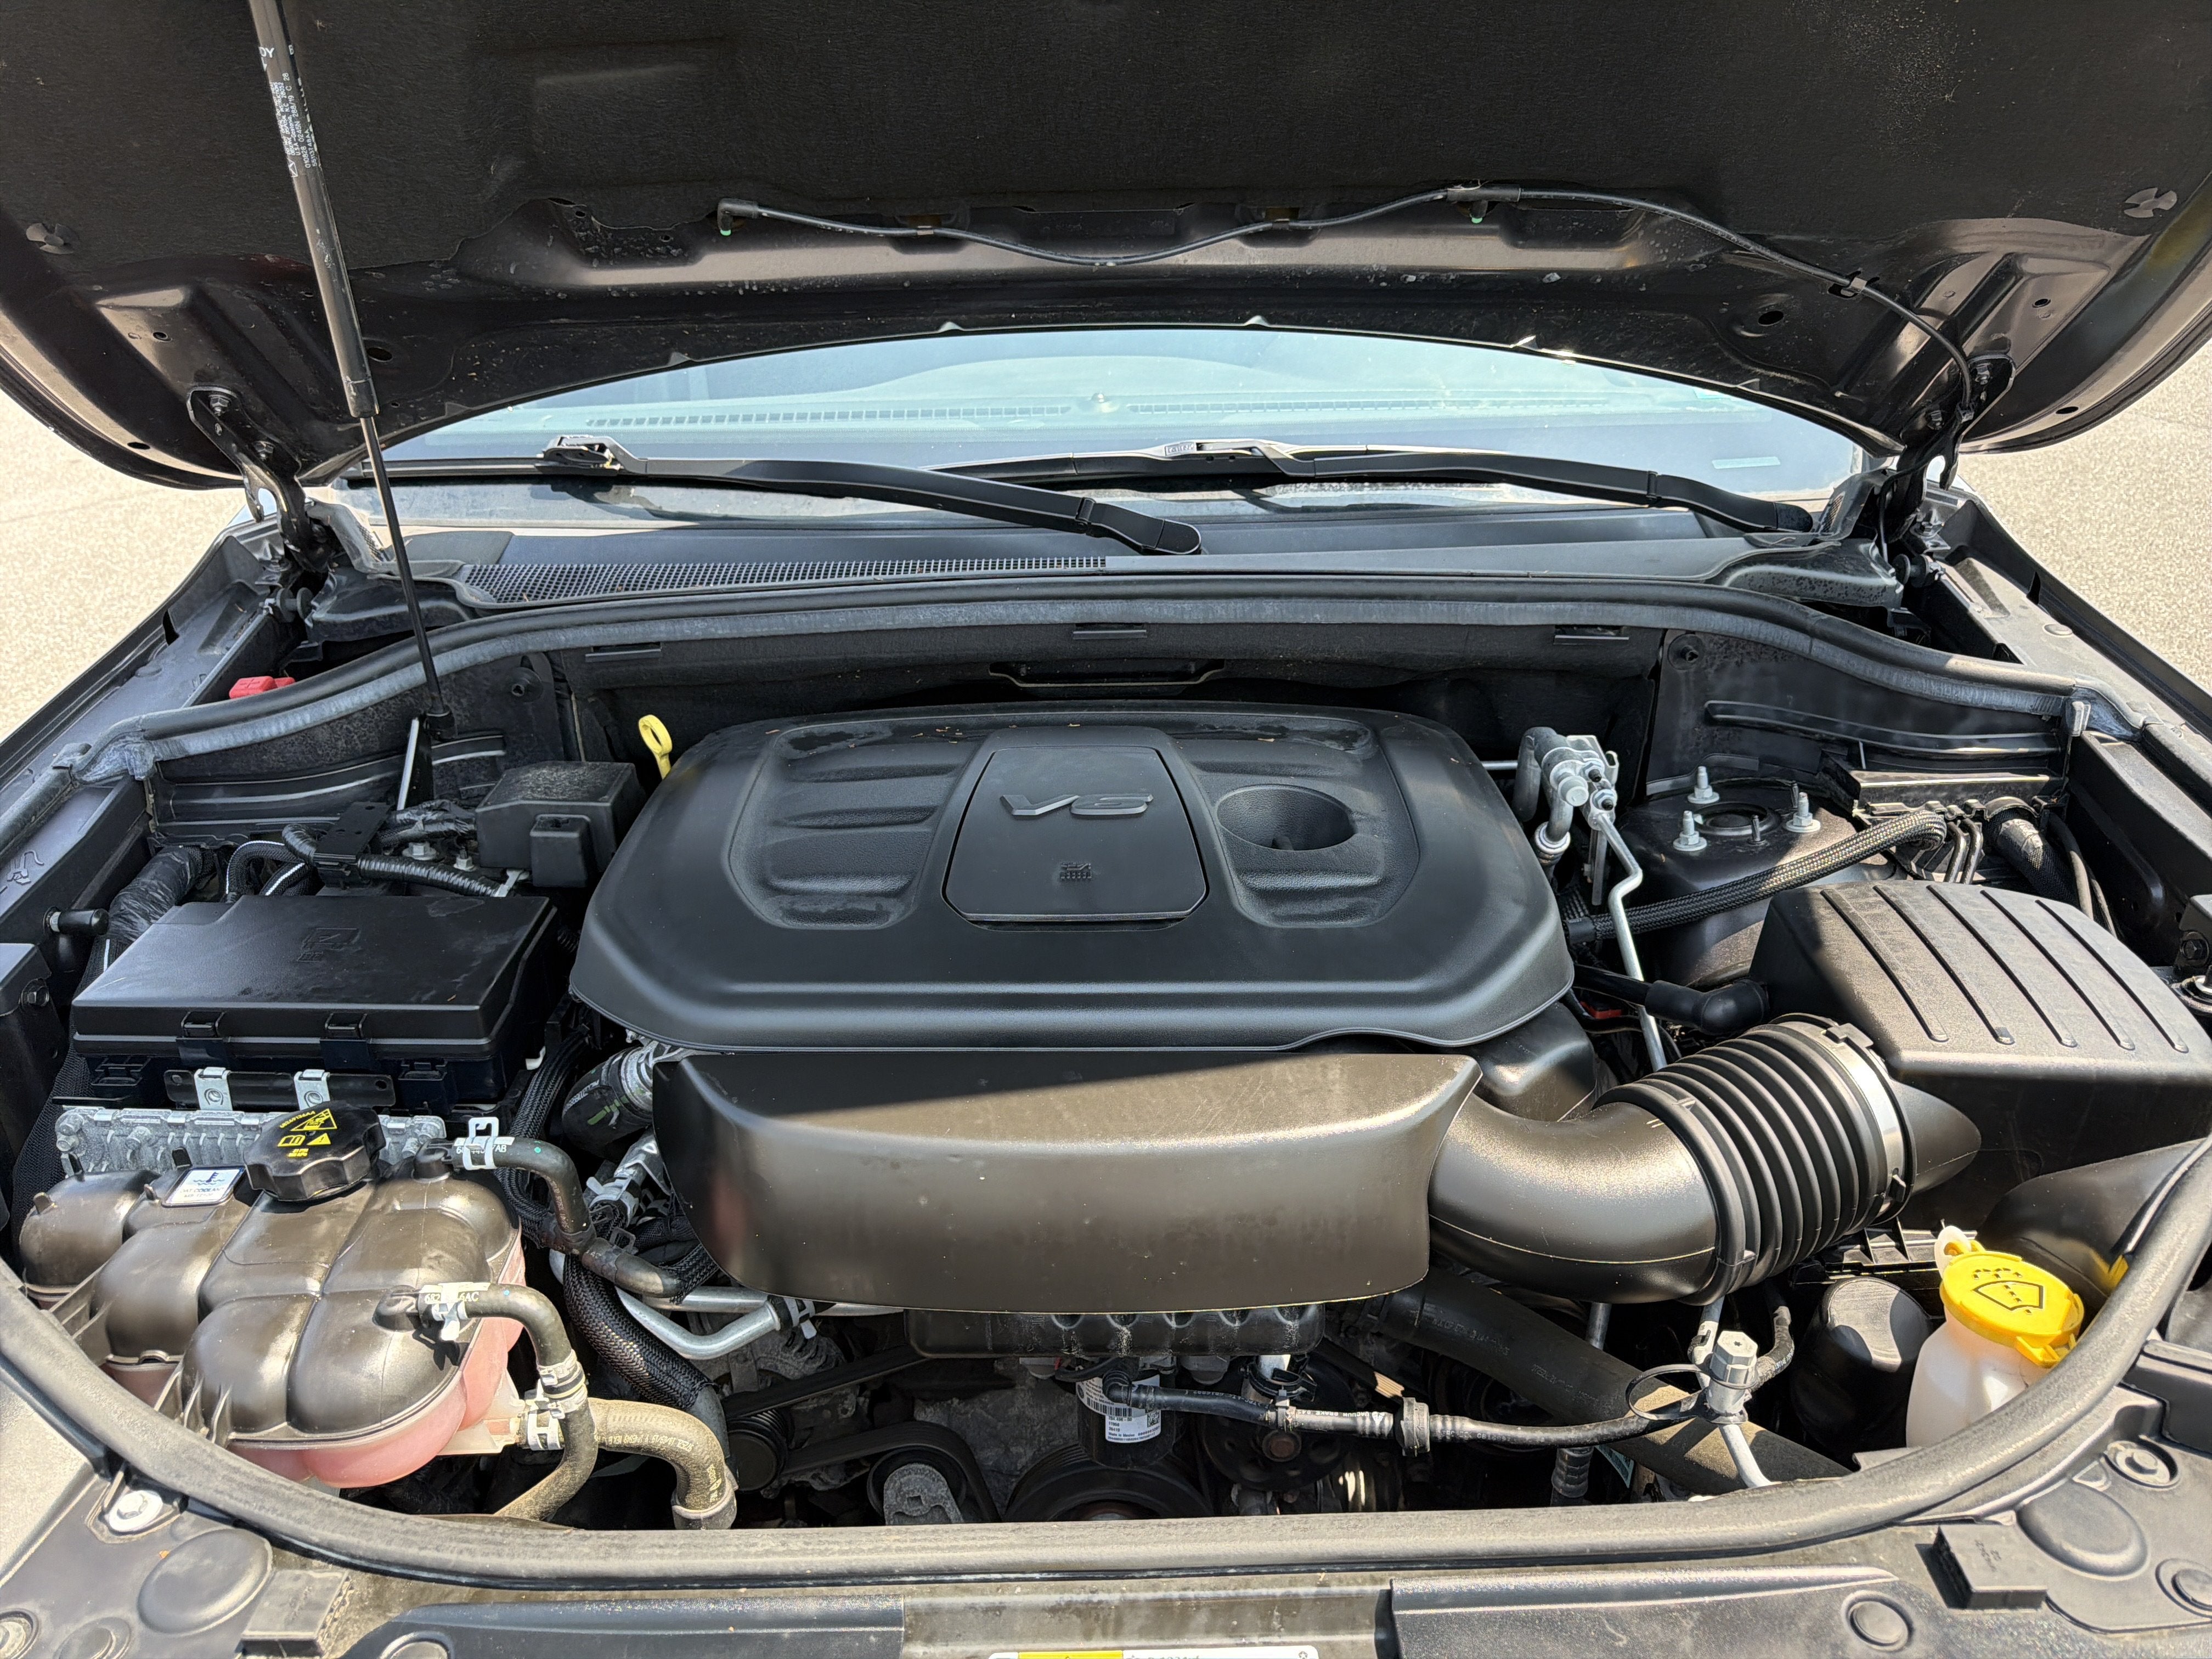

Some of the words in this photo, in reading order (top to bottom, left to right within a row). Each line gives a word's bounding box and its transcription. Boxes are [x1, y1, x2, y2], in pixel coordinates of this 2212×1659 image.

[283, 72, 290, 81] 28
[278, 82, 287, 99] 28052
[288, 95, 299, 117] 288/19
[294, 121, 304, 143] 0245N
[300, 146, 311, 168] 010828
[1000, 793, 1154, 816] V6
